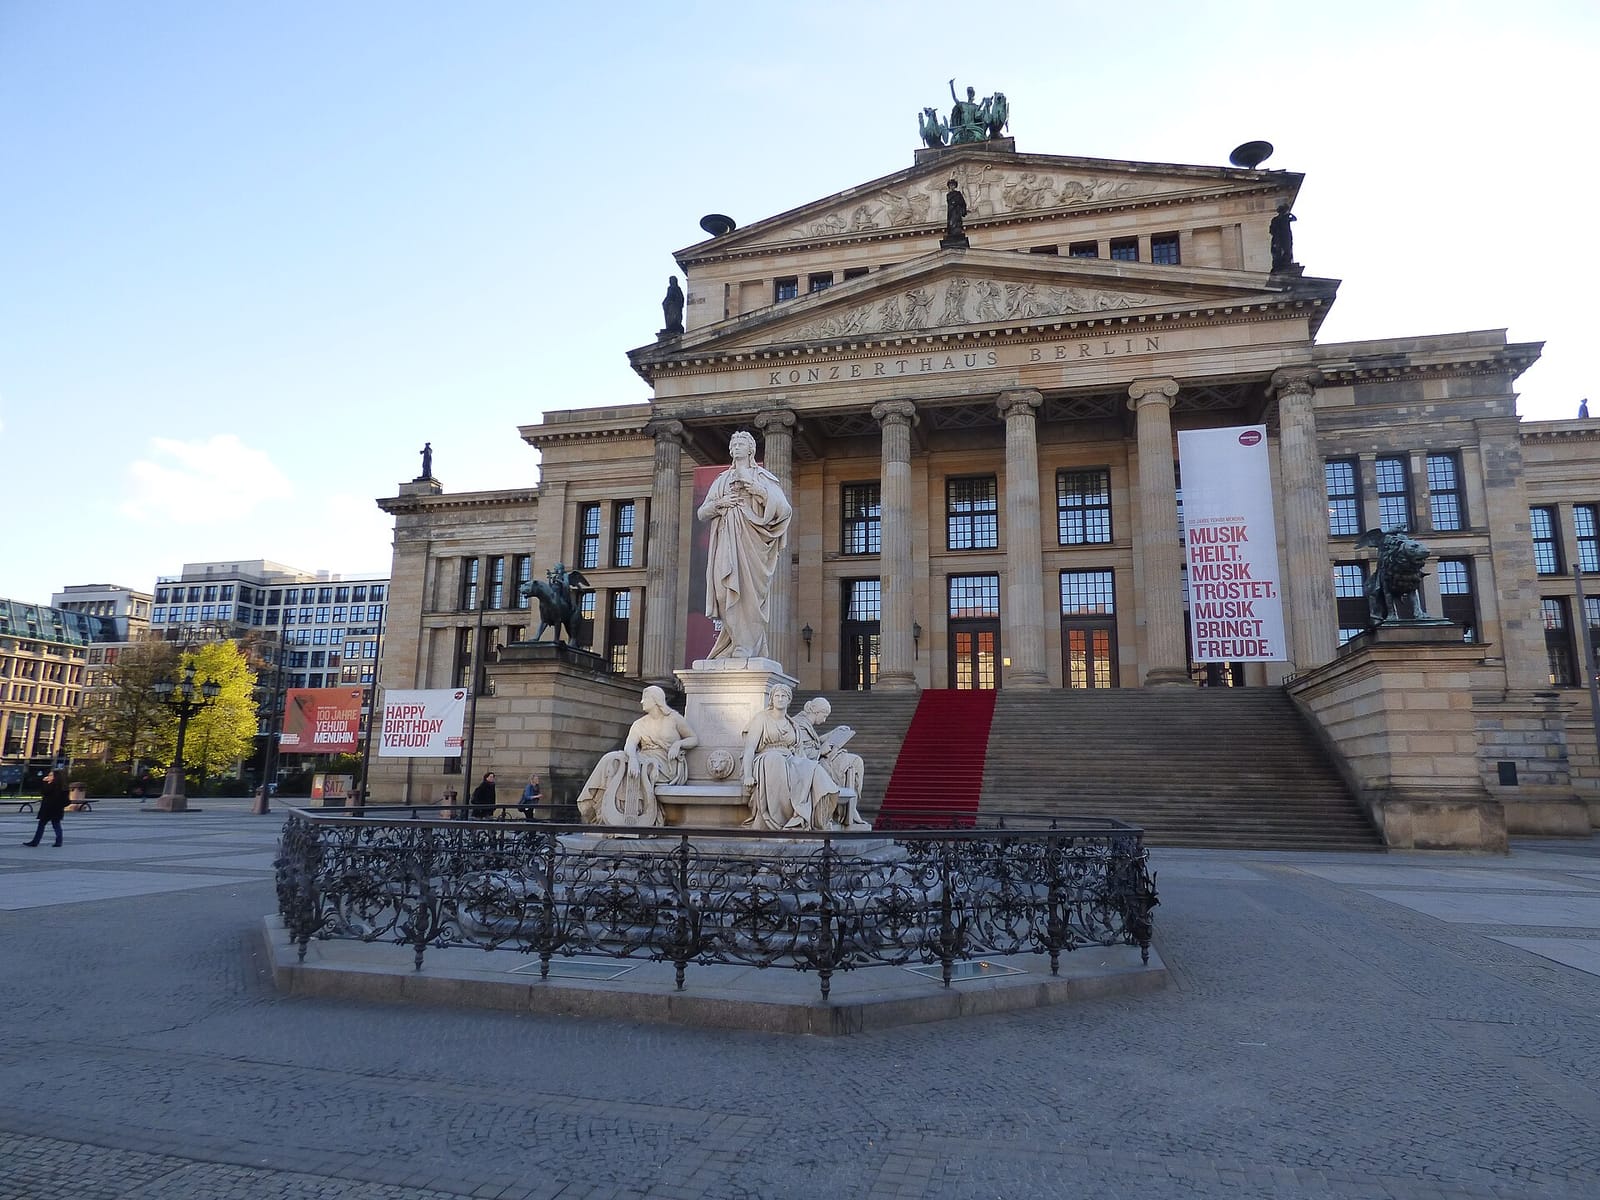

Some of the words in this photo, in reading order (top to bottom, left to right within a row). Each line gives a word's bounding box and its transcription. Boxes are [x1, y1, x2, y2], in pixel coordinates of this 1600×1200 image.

[769, 351, 998, 385] KONZERTHAUS
[1029, 336, 1159, 362] BERLIN
[1189, 525, 1248, 545] MUSIK
[1190, 545, 1242, 563] HEILT,
[1192, 563, 1251, 581] MUSIK
[1192, 581, 1276, 600] TRÖSTET,
[1195, 601, 1255, 619] MUSIK
[1196, 620, 1263, 638] BRINGT
[1197, 640, 1273, 658] FREUDE.
[317, 710, 330, 720] 100
[332, 709, 358, 720] JAHRE
[386, 706, 426, 719] HAPPY
[316, 721, 348, 732] YEHUDI
[384, 719, 443, 733] BIRTHDAY
[314, 732, 355, 744] MENUHIN.
[383, 734, 430, 747] YEHUDI!
[324, 780, 345, 793] SATZ
